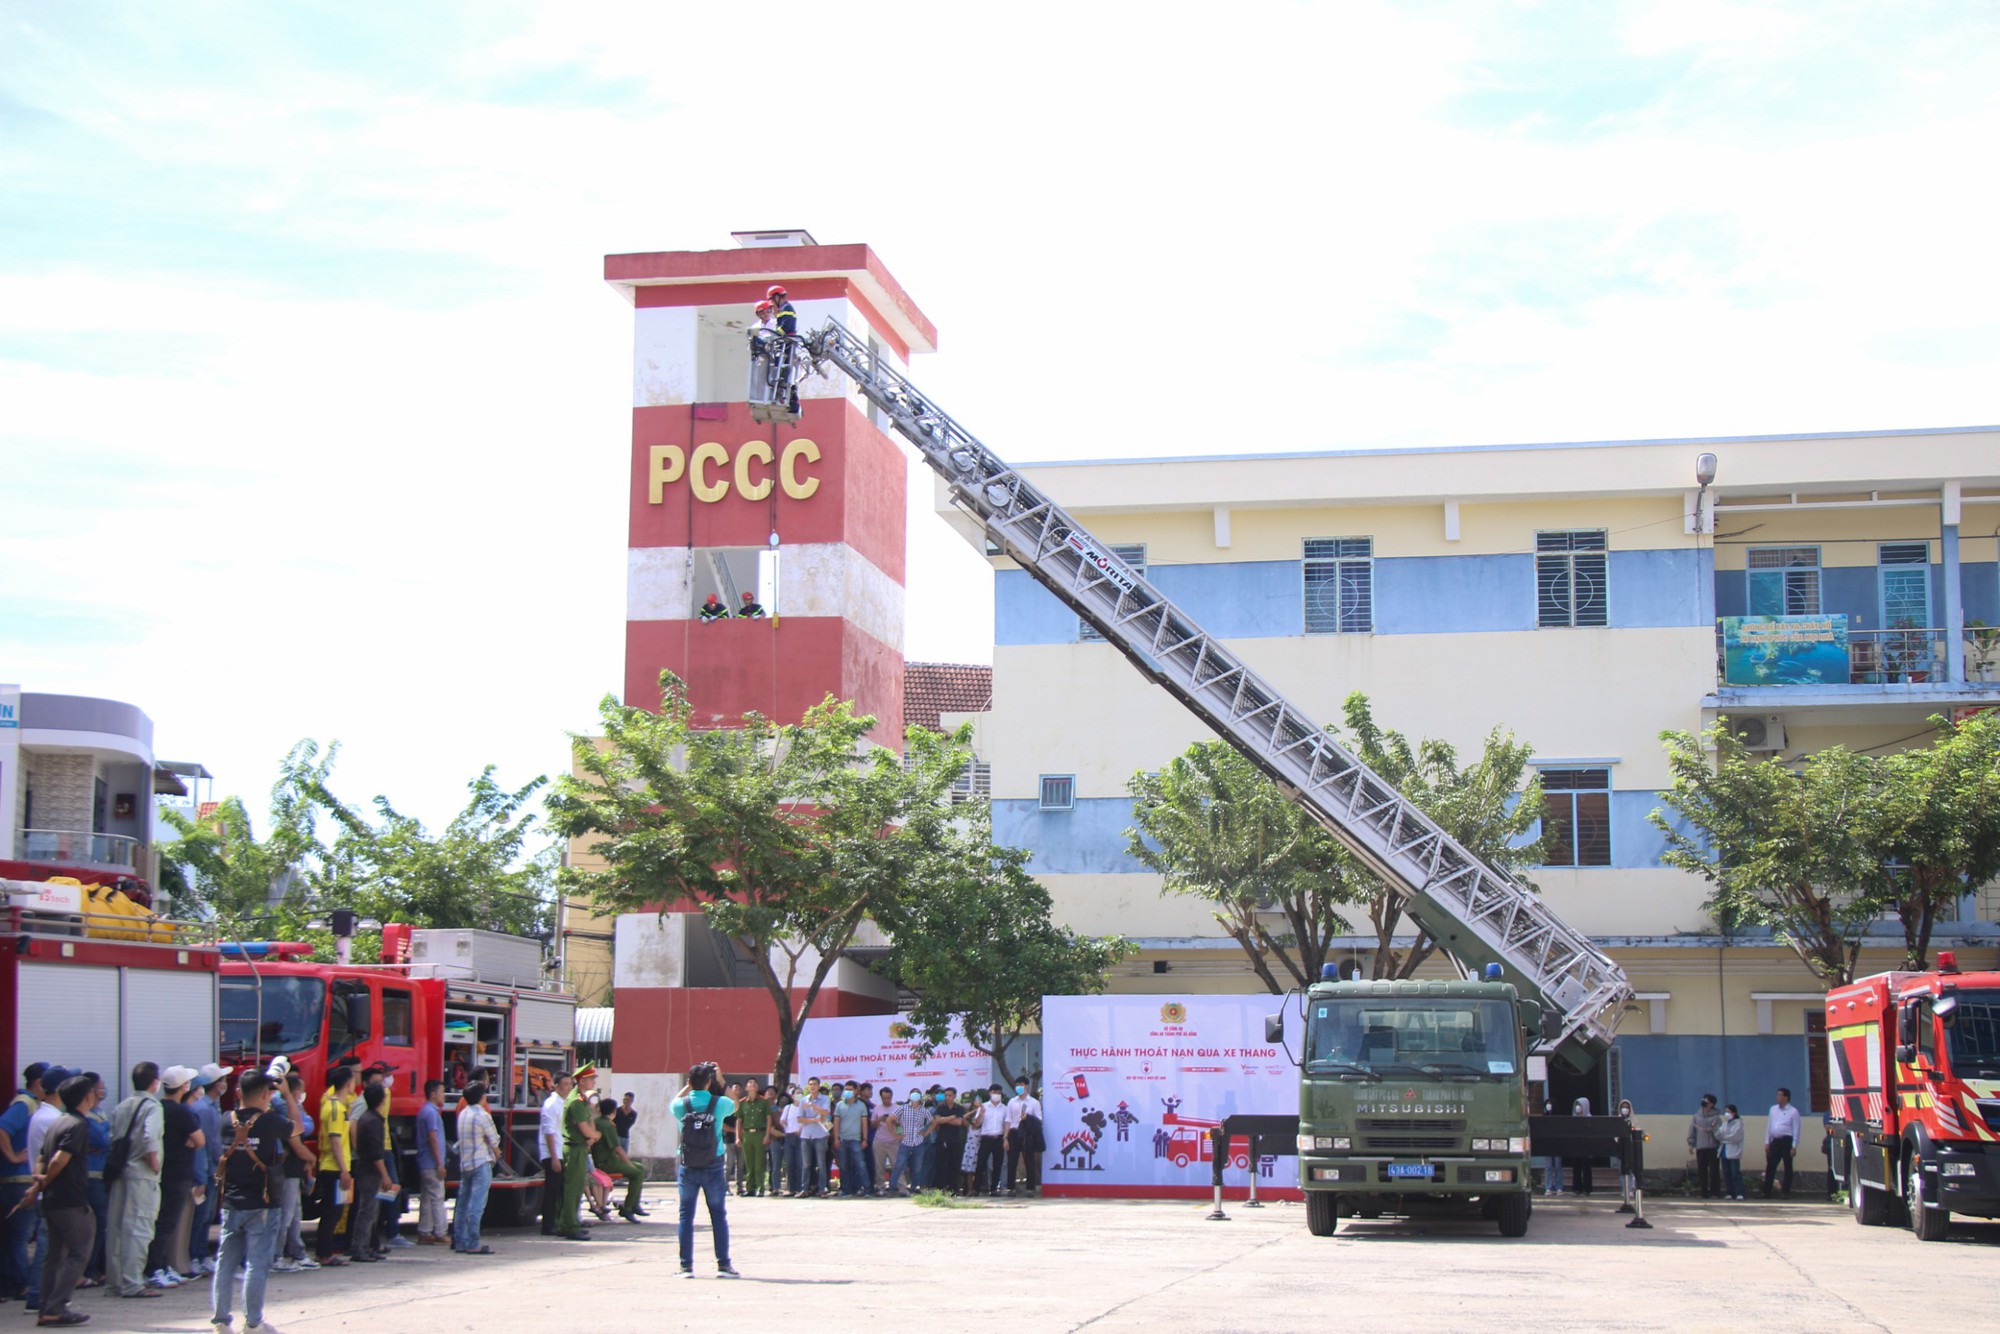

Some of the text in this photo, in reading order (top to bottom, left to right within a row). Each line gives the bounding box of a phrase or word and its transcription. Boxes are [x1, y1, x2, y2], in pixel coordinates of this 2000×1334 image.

[648, 438, 822, 505] PCCC
[1086, 551, 1133, 591] MORITA
[809, 1056, 831, 1065] THỰC
[834, 1054, 858, 1063] HÀNH
[860, 1052, 886, 1062] THOÁT
[889, 1053, 907, 1063] NẠN
[1070, 1046, 1276, 1060] THỰC HÀNH THOÁT NẠN QUA XE THANG
[1356, 1104, 1465, 1113] MITSUBISHI
